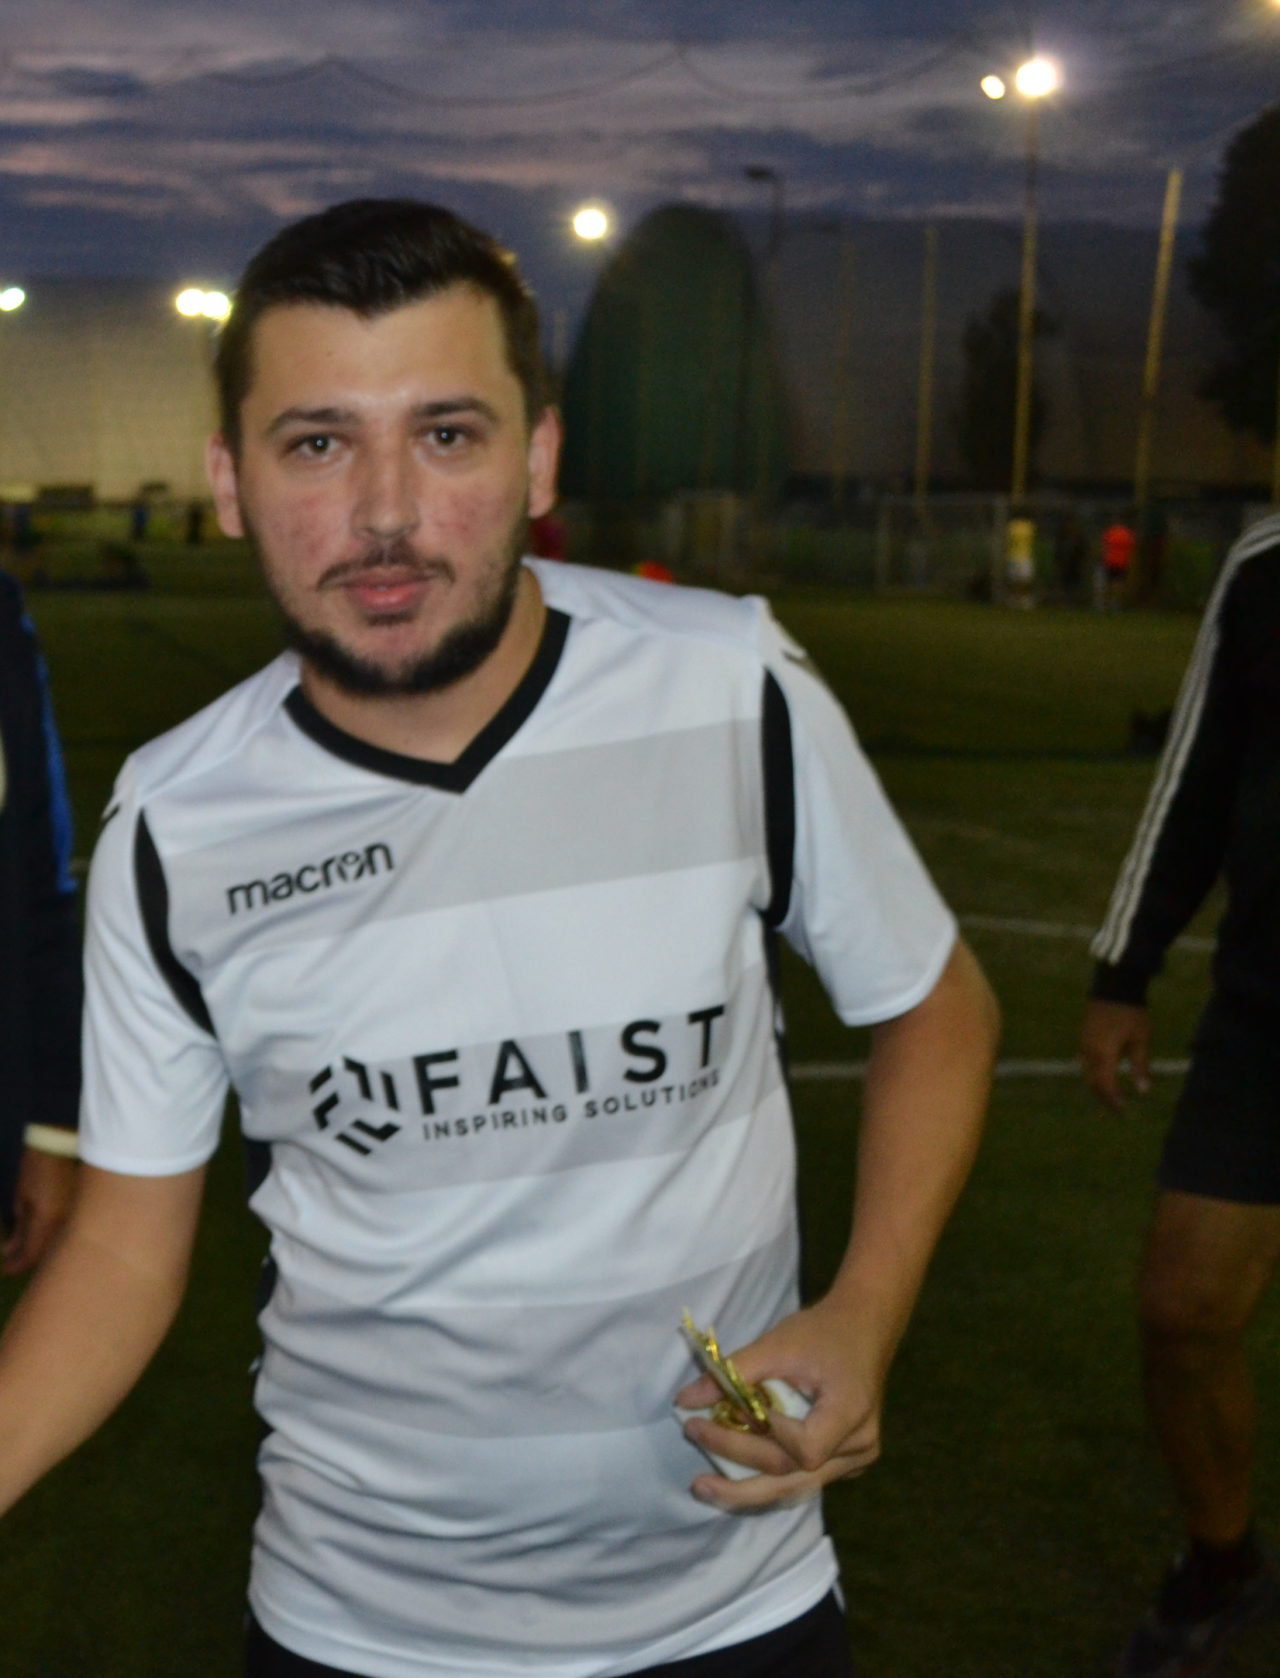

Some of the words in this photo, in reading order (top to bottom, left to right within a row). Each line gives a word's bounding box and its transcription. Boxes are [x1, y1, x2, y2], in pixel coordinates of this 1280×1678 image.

[227, 842, 394, 915] macron
[412, 1004, 724, 1114] FAIST
[423, 1104, 567, 1140] INSPIRING
[584, 1069, 719, 1118] SOLUTIONS
